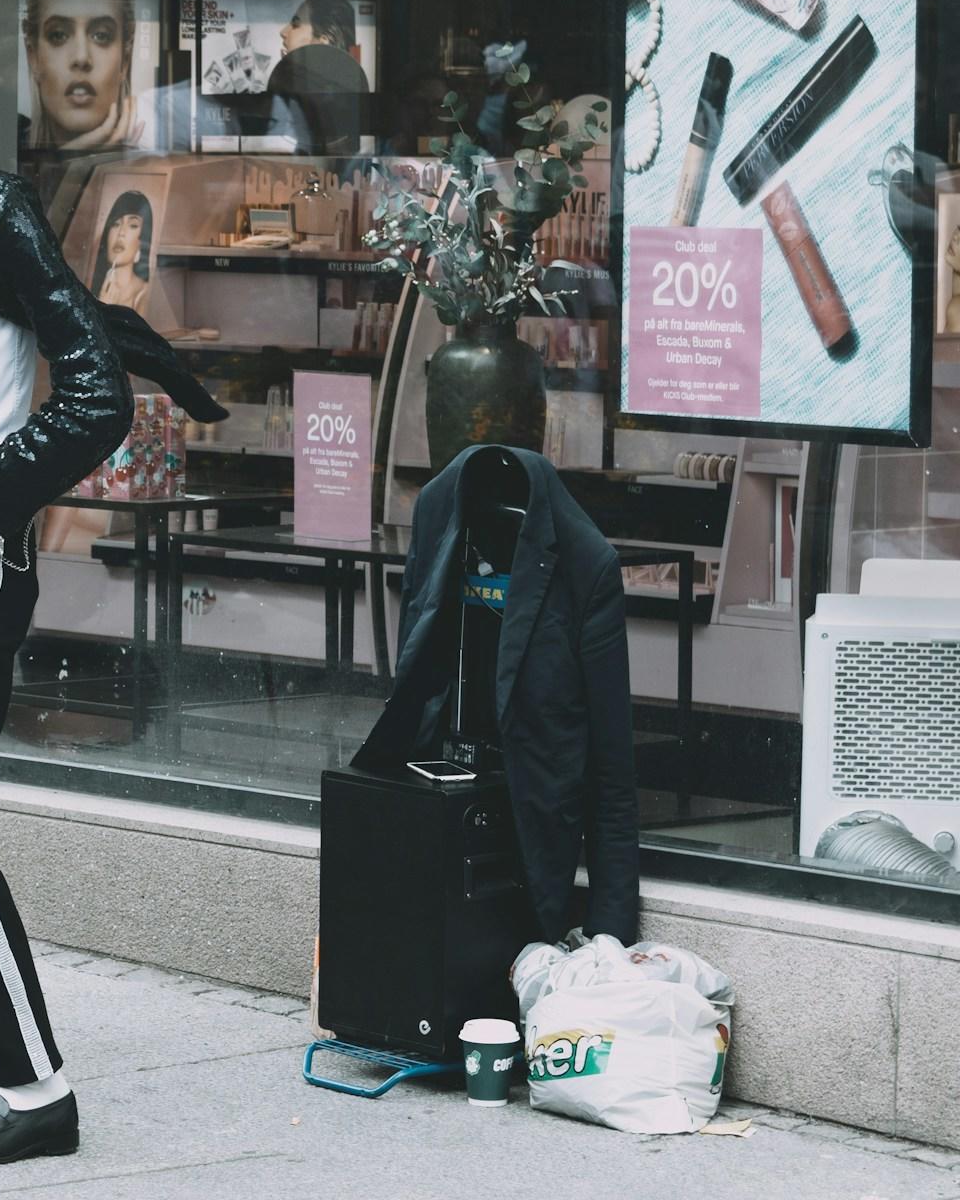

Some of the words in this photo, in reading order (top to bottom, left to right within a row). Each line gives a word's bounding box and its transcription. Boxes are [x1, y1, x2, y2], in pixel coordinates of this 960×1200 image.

[675, 240, 696, 253] Club
[697, 242, 717, 253] deal
[214, 258, 230, 267] NEW
[652, 260, 737, 311] 20%
[644, 319, 655, 331] på
[657, 318, 668, 330] alt
[670, 318, 683, 330] fra
[684, 318, 745, 334] bareMinerals,
[656, 335, 690, 349] Escada,
[692, 337, 722, 349] Buxom
[724, 337, 732, 349] &
[666, 351, 693, 364] Urban
[695, 352, 722, 368] Decay
[319, 401, 330, 410] Club
[331, 403, 343, 411] deal
[307, 413, 356, 445] 20%
[464, 584, 505, 601] IKEA
